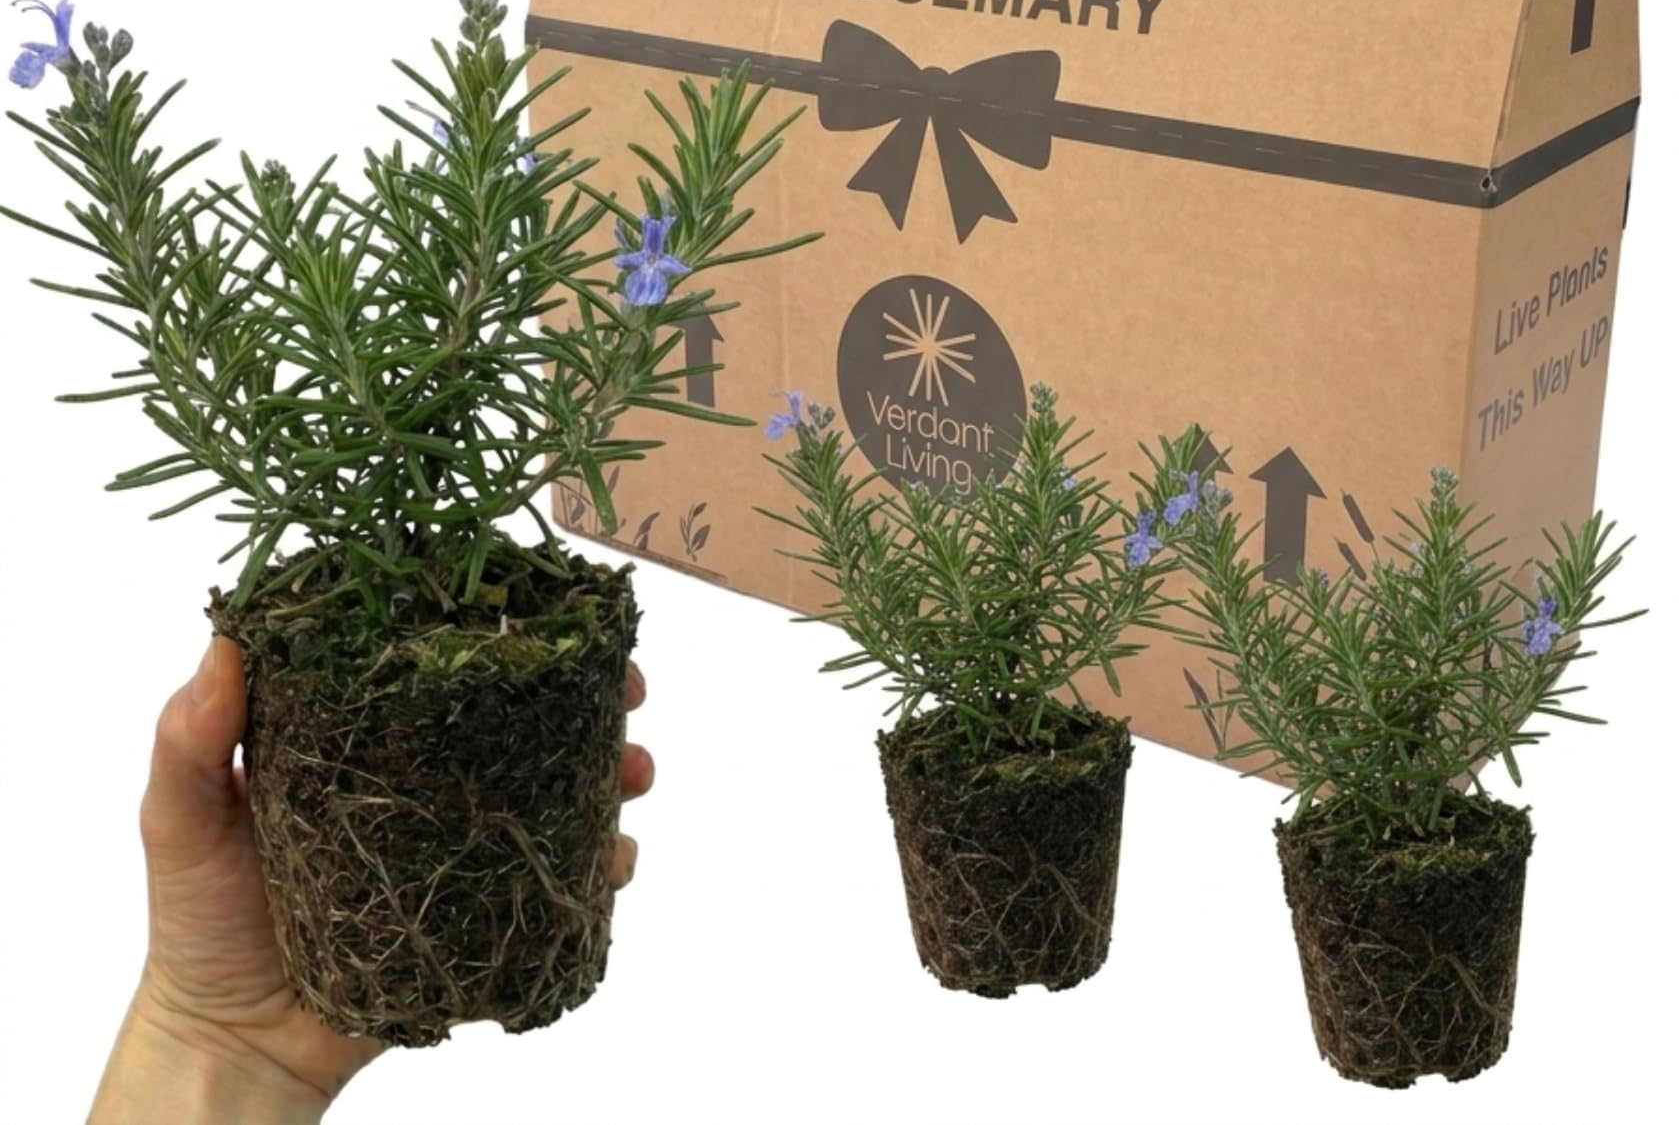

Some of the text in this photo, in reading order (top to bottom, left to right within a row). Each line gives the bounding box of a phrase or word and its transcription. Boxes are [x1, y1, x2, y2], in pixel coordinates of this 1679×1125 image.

[1494, 246, 1609, 356] Live Plants
[1477, 315, 1609, 452] This Way UP
[886, 433, 972, 496] Living
